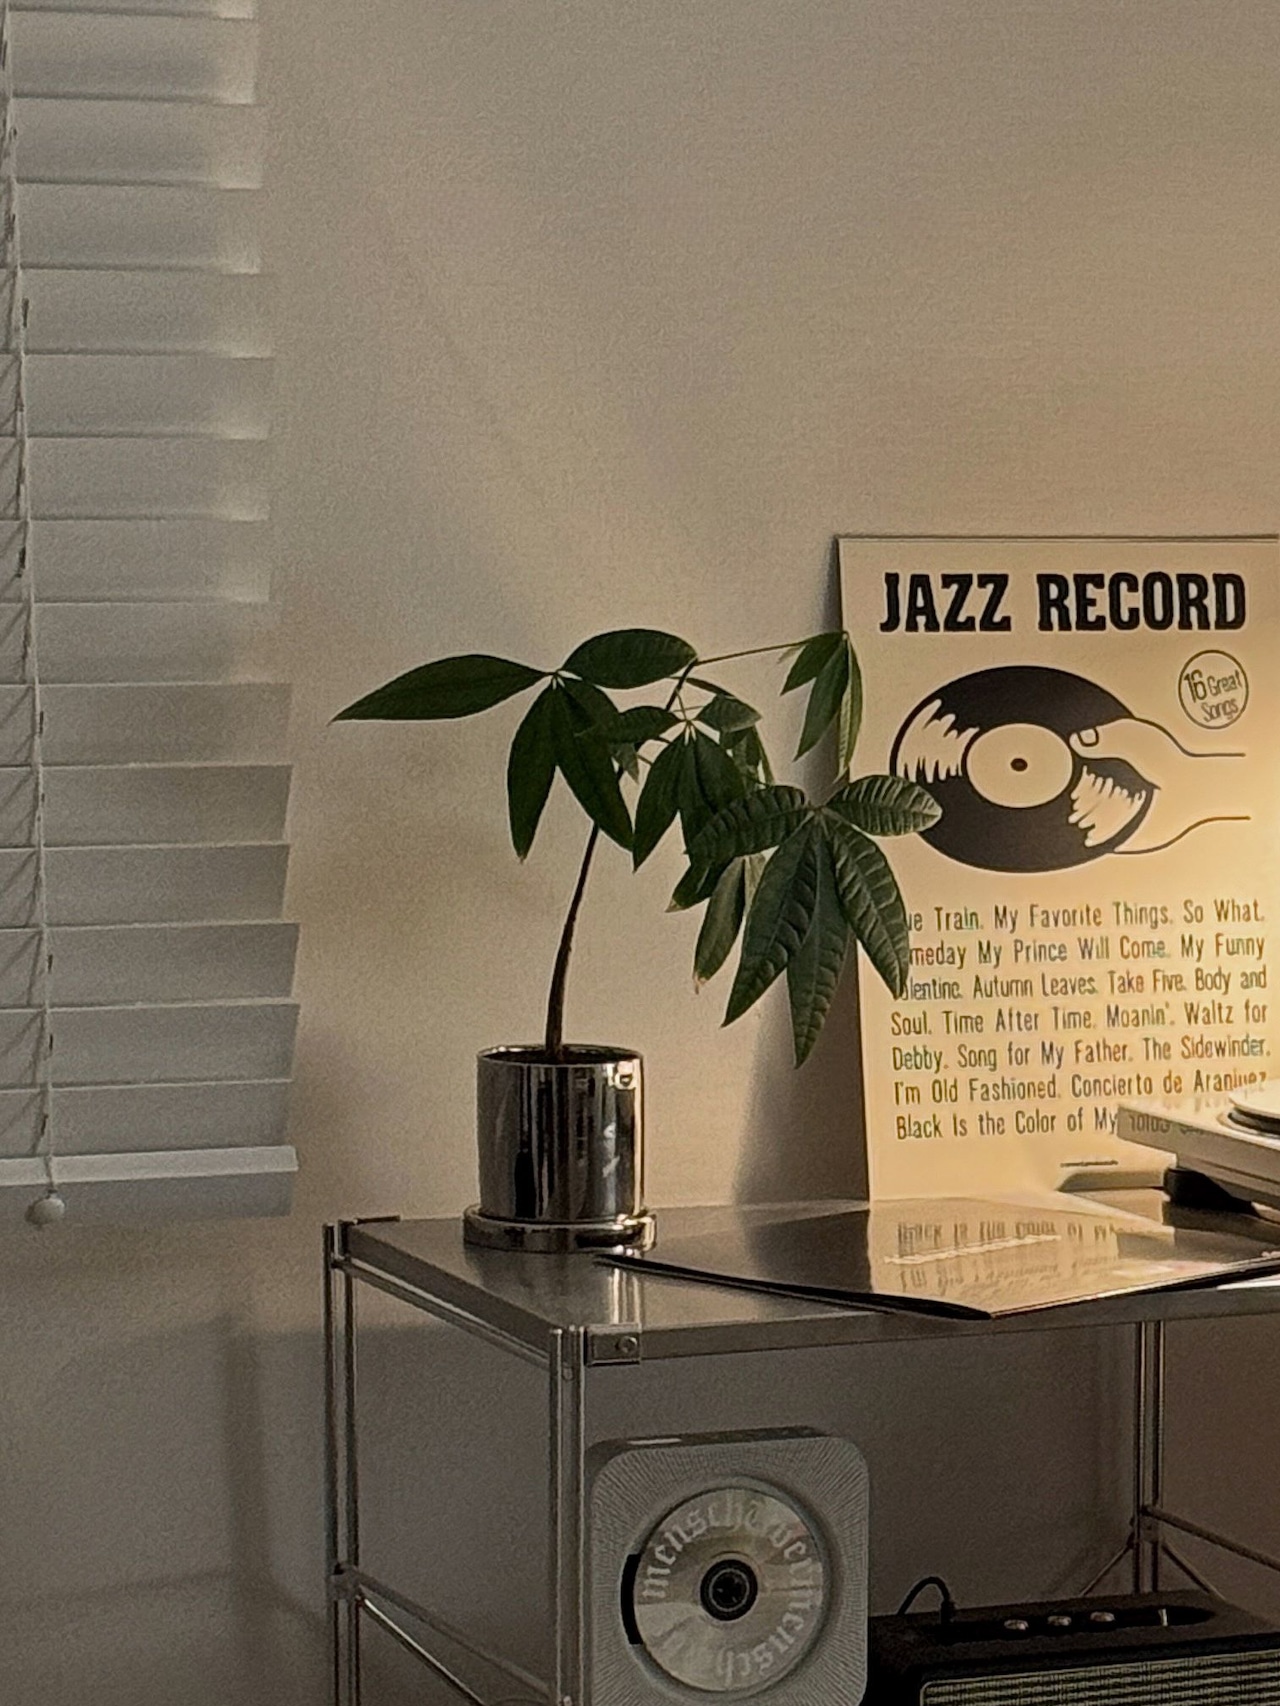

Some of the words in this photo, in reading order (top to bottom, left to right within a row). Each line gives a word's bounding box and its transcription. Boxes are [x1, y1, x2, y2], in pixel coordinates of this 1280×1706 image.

[879, 571, 1012, 632] JAZZ
[1036, 570, 1247, 631] RECORD
[1184, 669, 1207, 703] 16
[1206, 669, 1242, 696] Great
[1200, 698, 1239, 722] Songs
[934, 905, 984, 932] Train.
[994, 904, 1019, 934] My
[1029, 903, 1103, 928] Favorite
[1112, 900, 1174, 930] Things.
[1183, 898, 1204, 923] So
[1214, 898, 1266, 923] What.
[908, 939, 967, 970] meday
[977, 939, 1002, 969] My
[1014, 938, 1068, 964] Prince
[1077, 935, 1110, 960] Will
[1180, 933, 1204, 962] My
[1215, 932, 1266, 961] Funny
[901, 974, 963, 1000] alentine.
[973, 974, 1034, 999] Autumn
[1107, 969, 1145, 995] Take
[1195, 964, 1232, 995] Body
[1240, 964, 1267, 990] and
[891, 1010, 932, 1037] Soul.
[941, 1009, 984, 1035] Time
[995, 1006, 1039, 1032] After
[1051, 1004, 1097, 1030] Time.
[1184, 999, 1234, 1026] Waltz
[1244, 998, 1268, 1024] for
[892, 1044, 950, 1074] Debby.
[957, 1043, 998, 1072] Song
[1007, 1041, 1031, 1066] for
[1041, 1040, 1064, 1070] My
[1074, 1037, 1134, 1064] Father.
[1142, 1036, 1172, 1061] The
[1181, 1033, 1272, 1060] Sidewinder.
[893, 1080, 921, 1106] I'm
[931, 1076, 958, 1104] Old
[969, 1073, 1062, 1102] Fashioned.
[1071, 1072, 1153, 1099] Concierto
[1162, 1069, 1183, 1095] de
[896, 1112, 943, 1141] Black
[953, 1112, 968, 1137] Is
[978, 1109, 1006, 1136] the
[1014, 1107, 1057, 1134] Color
[1066, 1106, 1084, 1132] of
[1093, 1106, 1118, 1135] My
